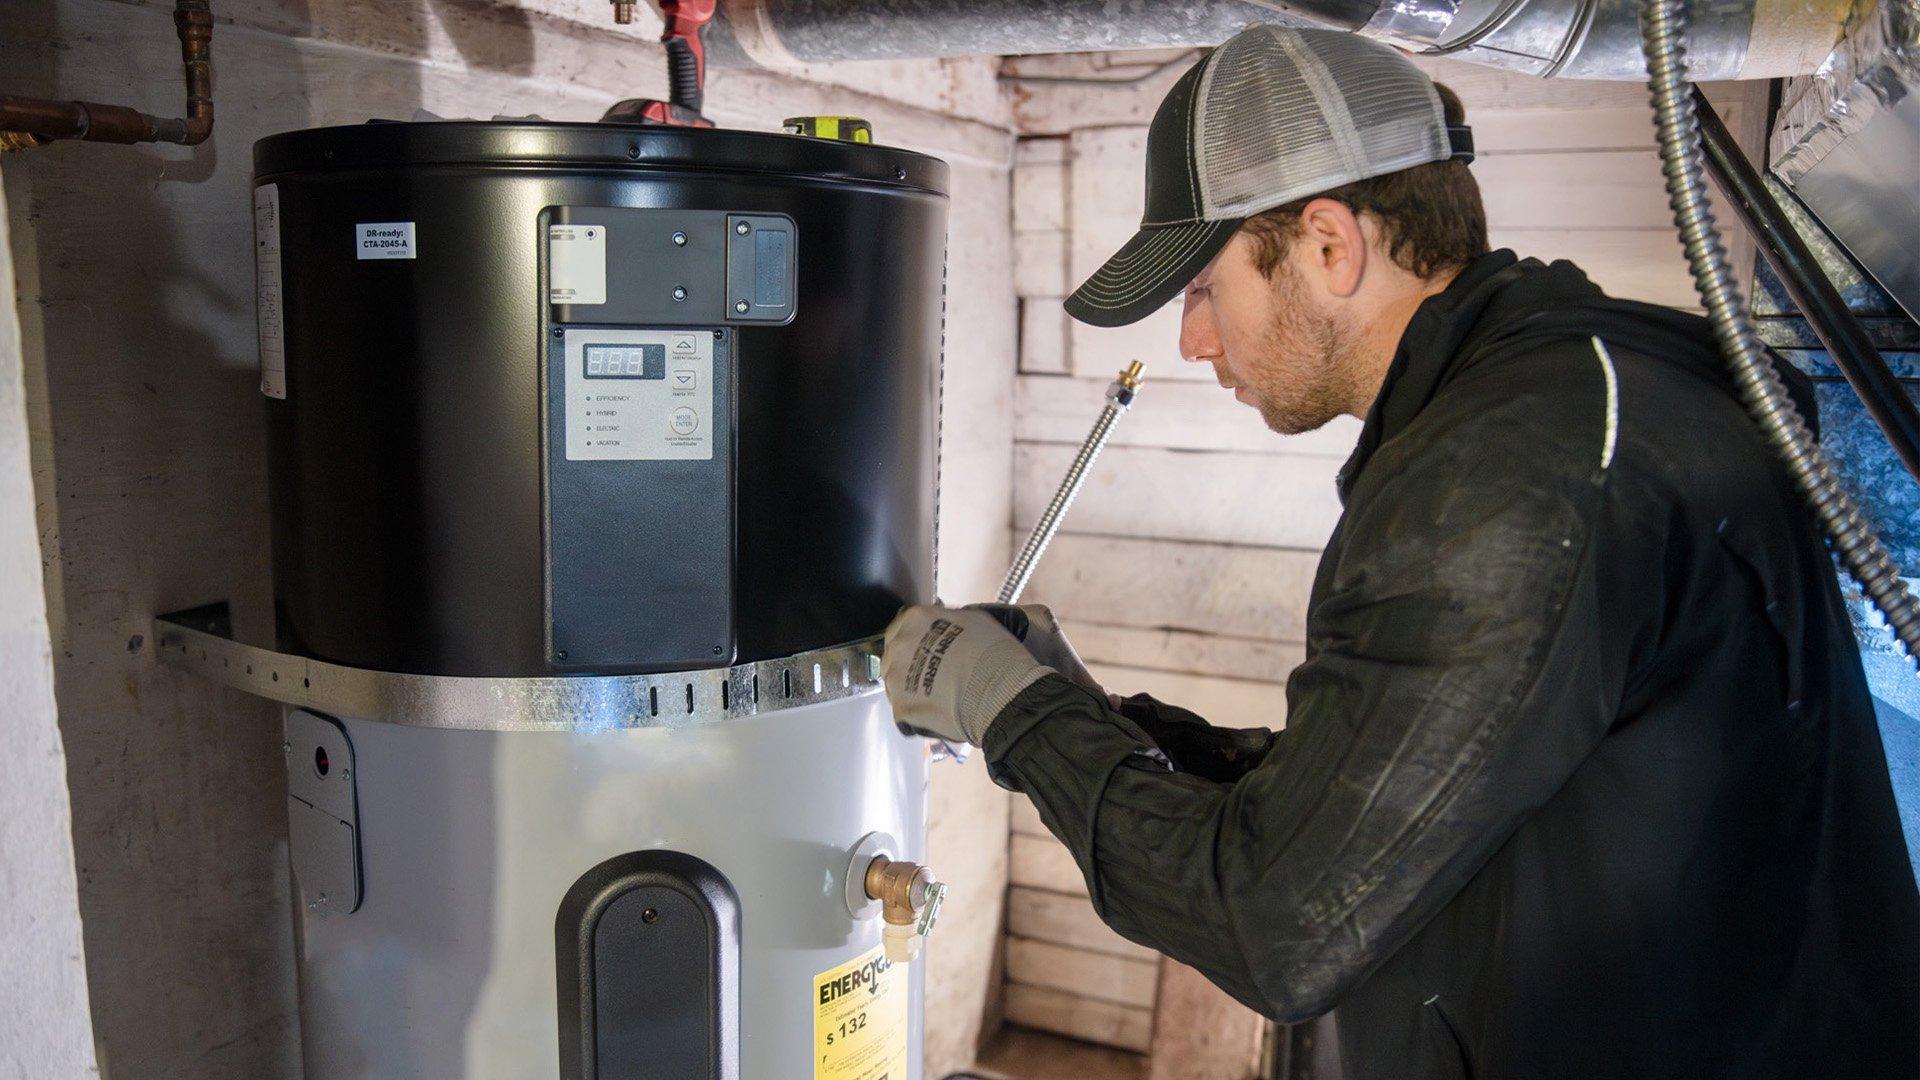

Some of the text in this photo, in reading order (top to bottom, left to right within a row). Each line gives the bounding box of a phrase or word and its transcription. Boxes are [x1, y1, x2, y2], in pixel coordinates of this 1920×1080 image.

[363, 240, 408, 248] CTA-2045-A
[366, 229, 404, 238] DR-ready:
[935, 624, 964, 655] FIRM
[922, 655, 942, 696] GRIP
[839, 1012, 867, 1038] 132
